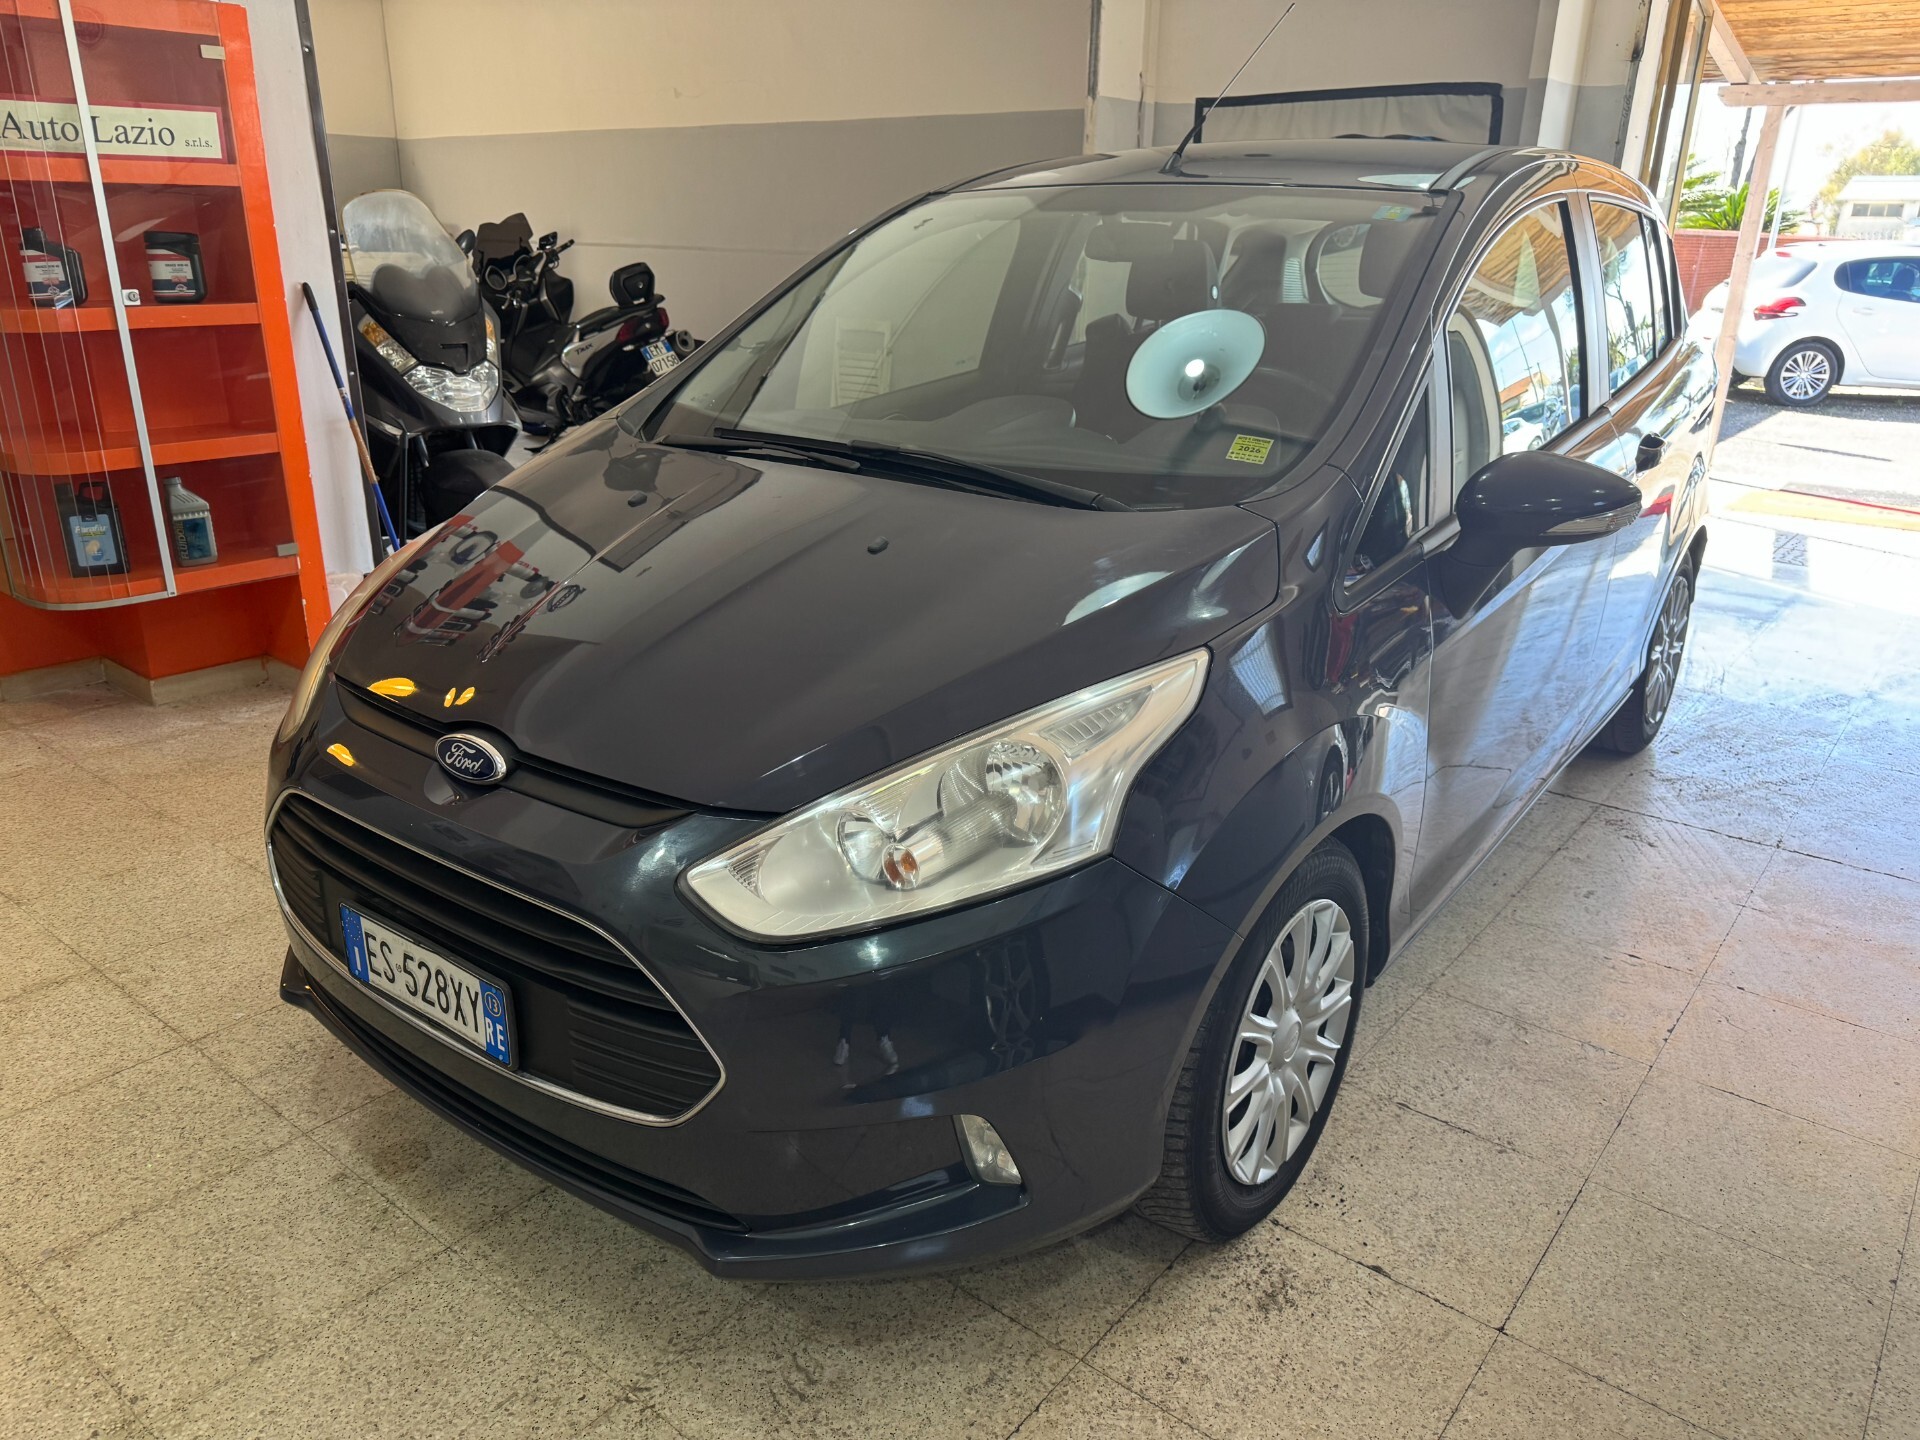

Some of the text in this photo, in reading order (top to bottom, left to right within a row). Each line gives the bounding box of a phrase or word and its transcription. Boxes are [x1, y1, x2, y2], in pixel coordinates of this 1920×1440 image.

[0, 111, 213, 148] Auto Lazio s.r.l.s.
[1239, 446, 1261, 454] 2026
[445, 742, 484, 774] Ford
[364, 931, 396, 984] ES
[402, 952, 480, 1033] 528XY
[487, 996, 499, 1013] 13
[484, 1017, 506, 1052] RE
